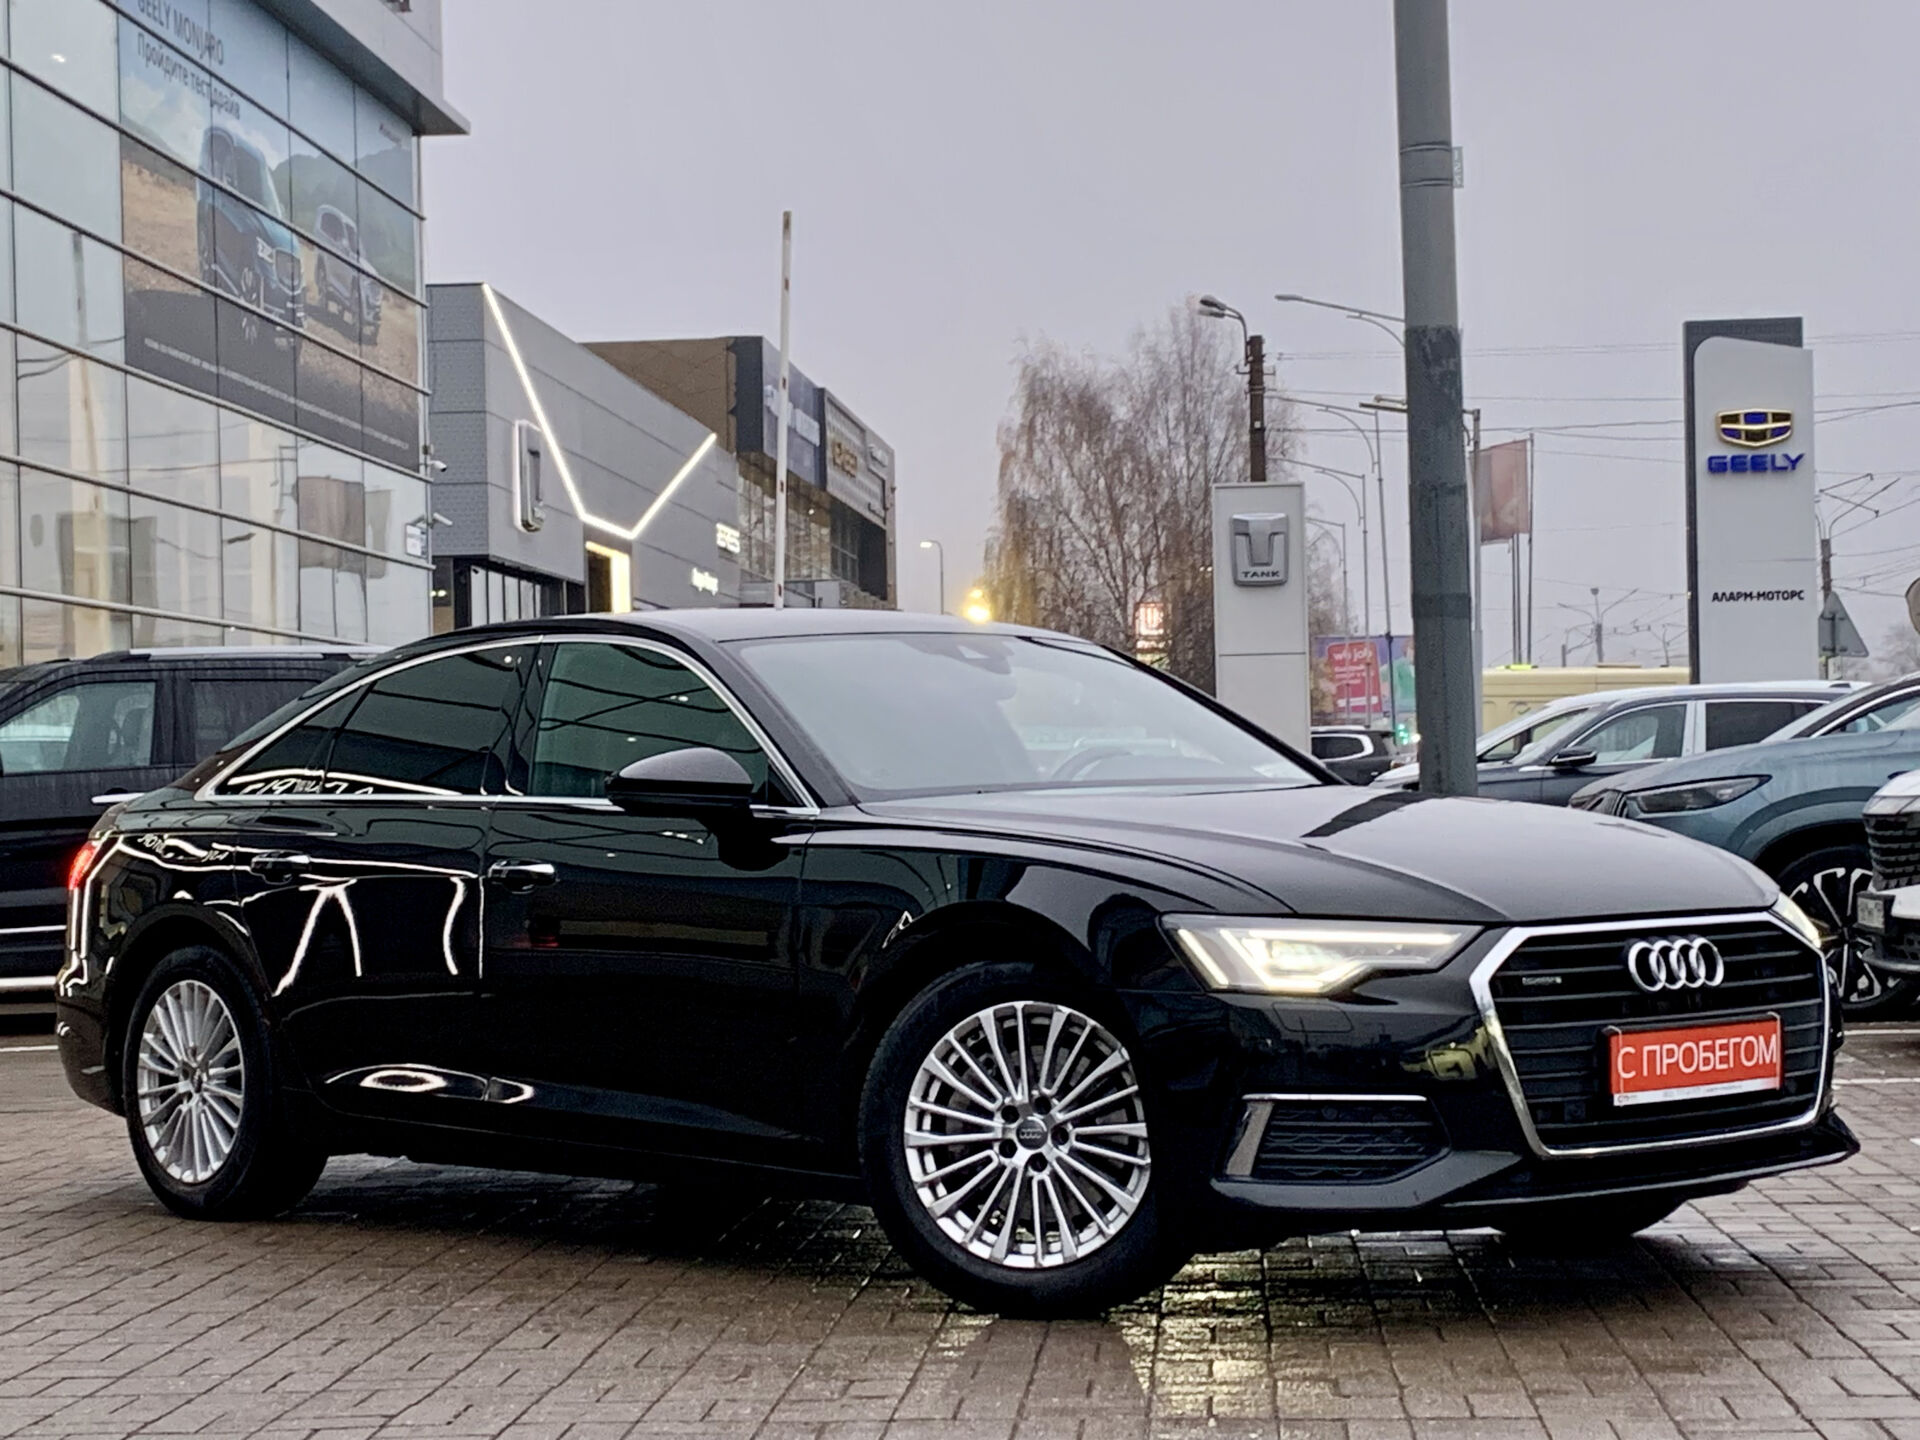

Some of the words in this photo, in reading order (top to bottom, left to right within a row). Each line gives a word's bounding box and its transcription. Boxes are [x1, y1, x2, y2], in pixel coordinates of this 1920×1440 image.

[173, 8, 224, 66] MONJARO
[137, 32, 189, 86] Пройдите
[1707, 453, 1806, 473] GEELY
[1241, 570, 1280, 578] TANK
[1712, 589, 1805, 602] АЛАРМ-МОТОРС
[1617, 1046, 1637, 1079] С
[1642, 1033, 1778, 1077] ПРОБЕГОМ
